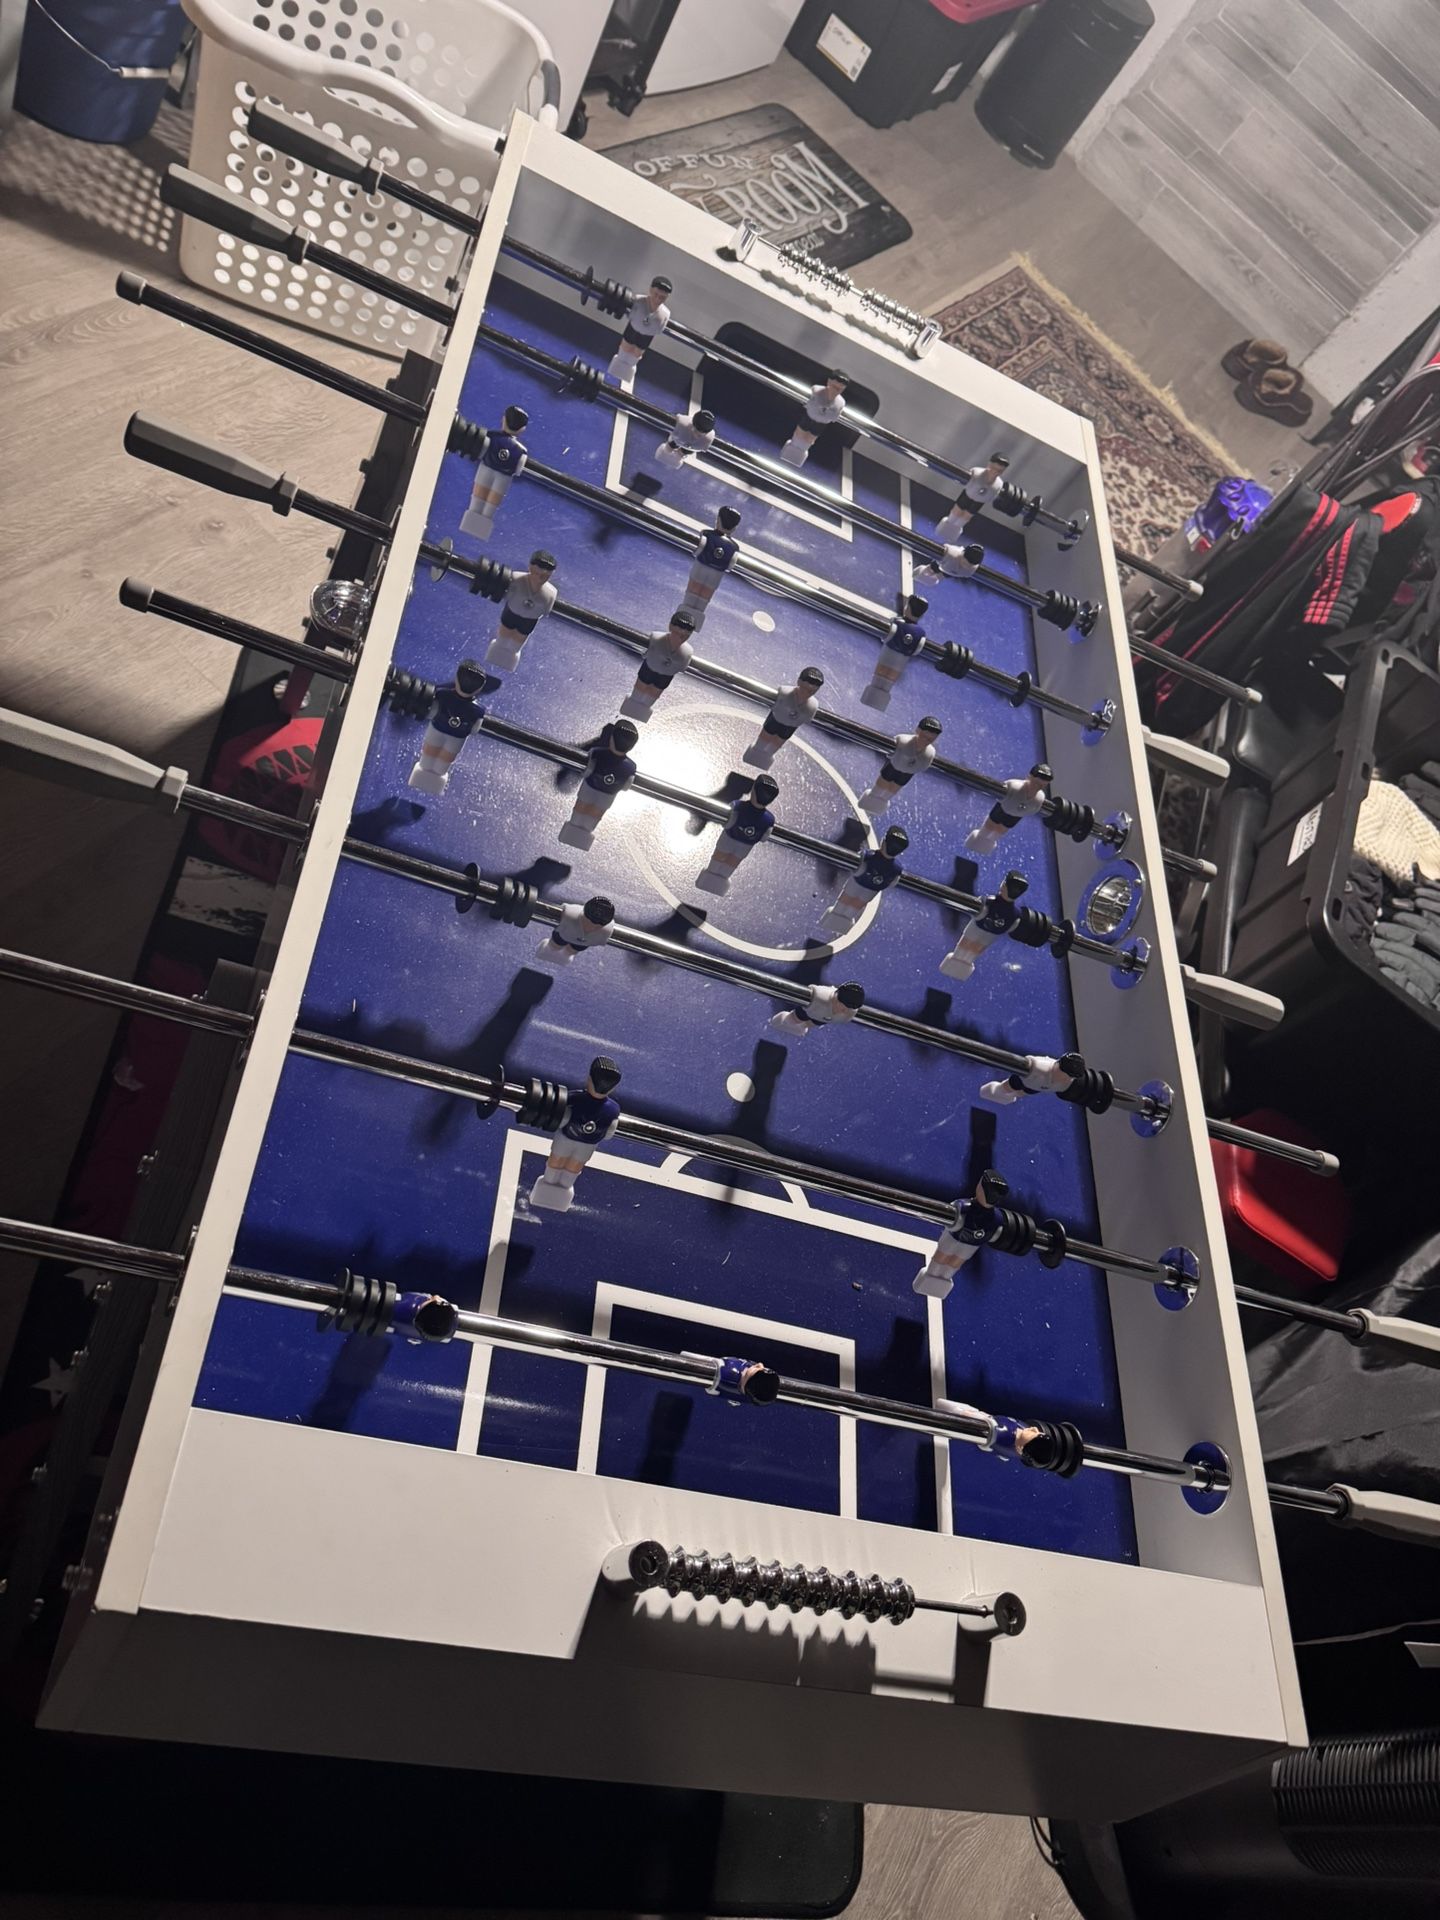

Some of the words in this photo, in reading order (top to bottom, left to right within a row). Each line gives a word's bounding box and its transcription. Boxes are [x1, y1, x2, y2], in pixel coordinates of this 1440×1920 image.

[634, 156, 672, 176] OF
[677, 153, 754, 170] FUN
[713, 141, 869, 233] ROOM
